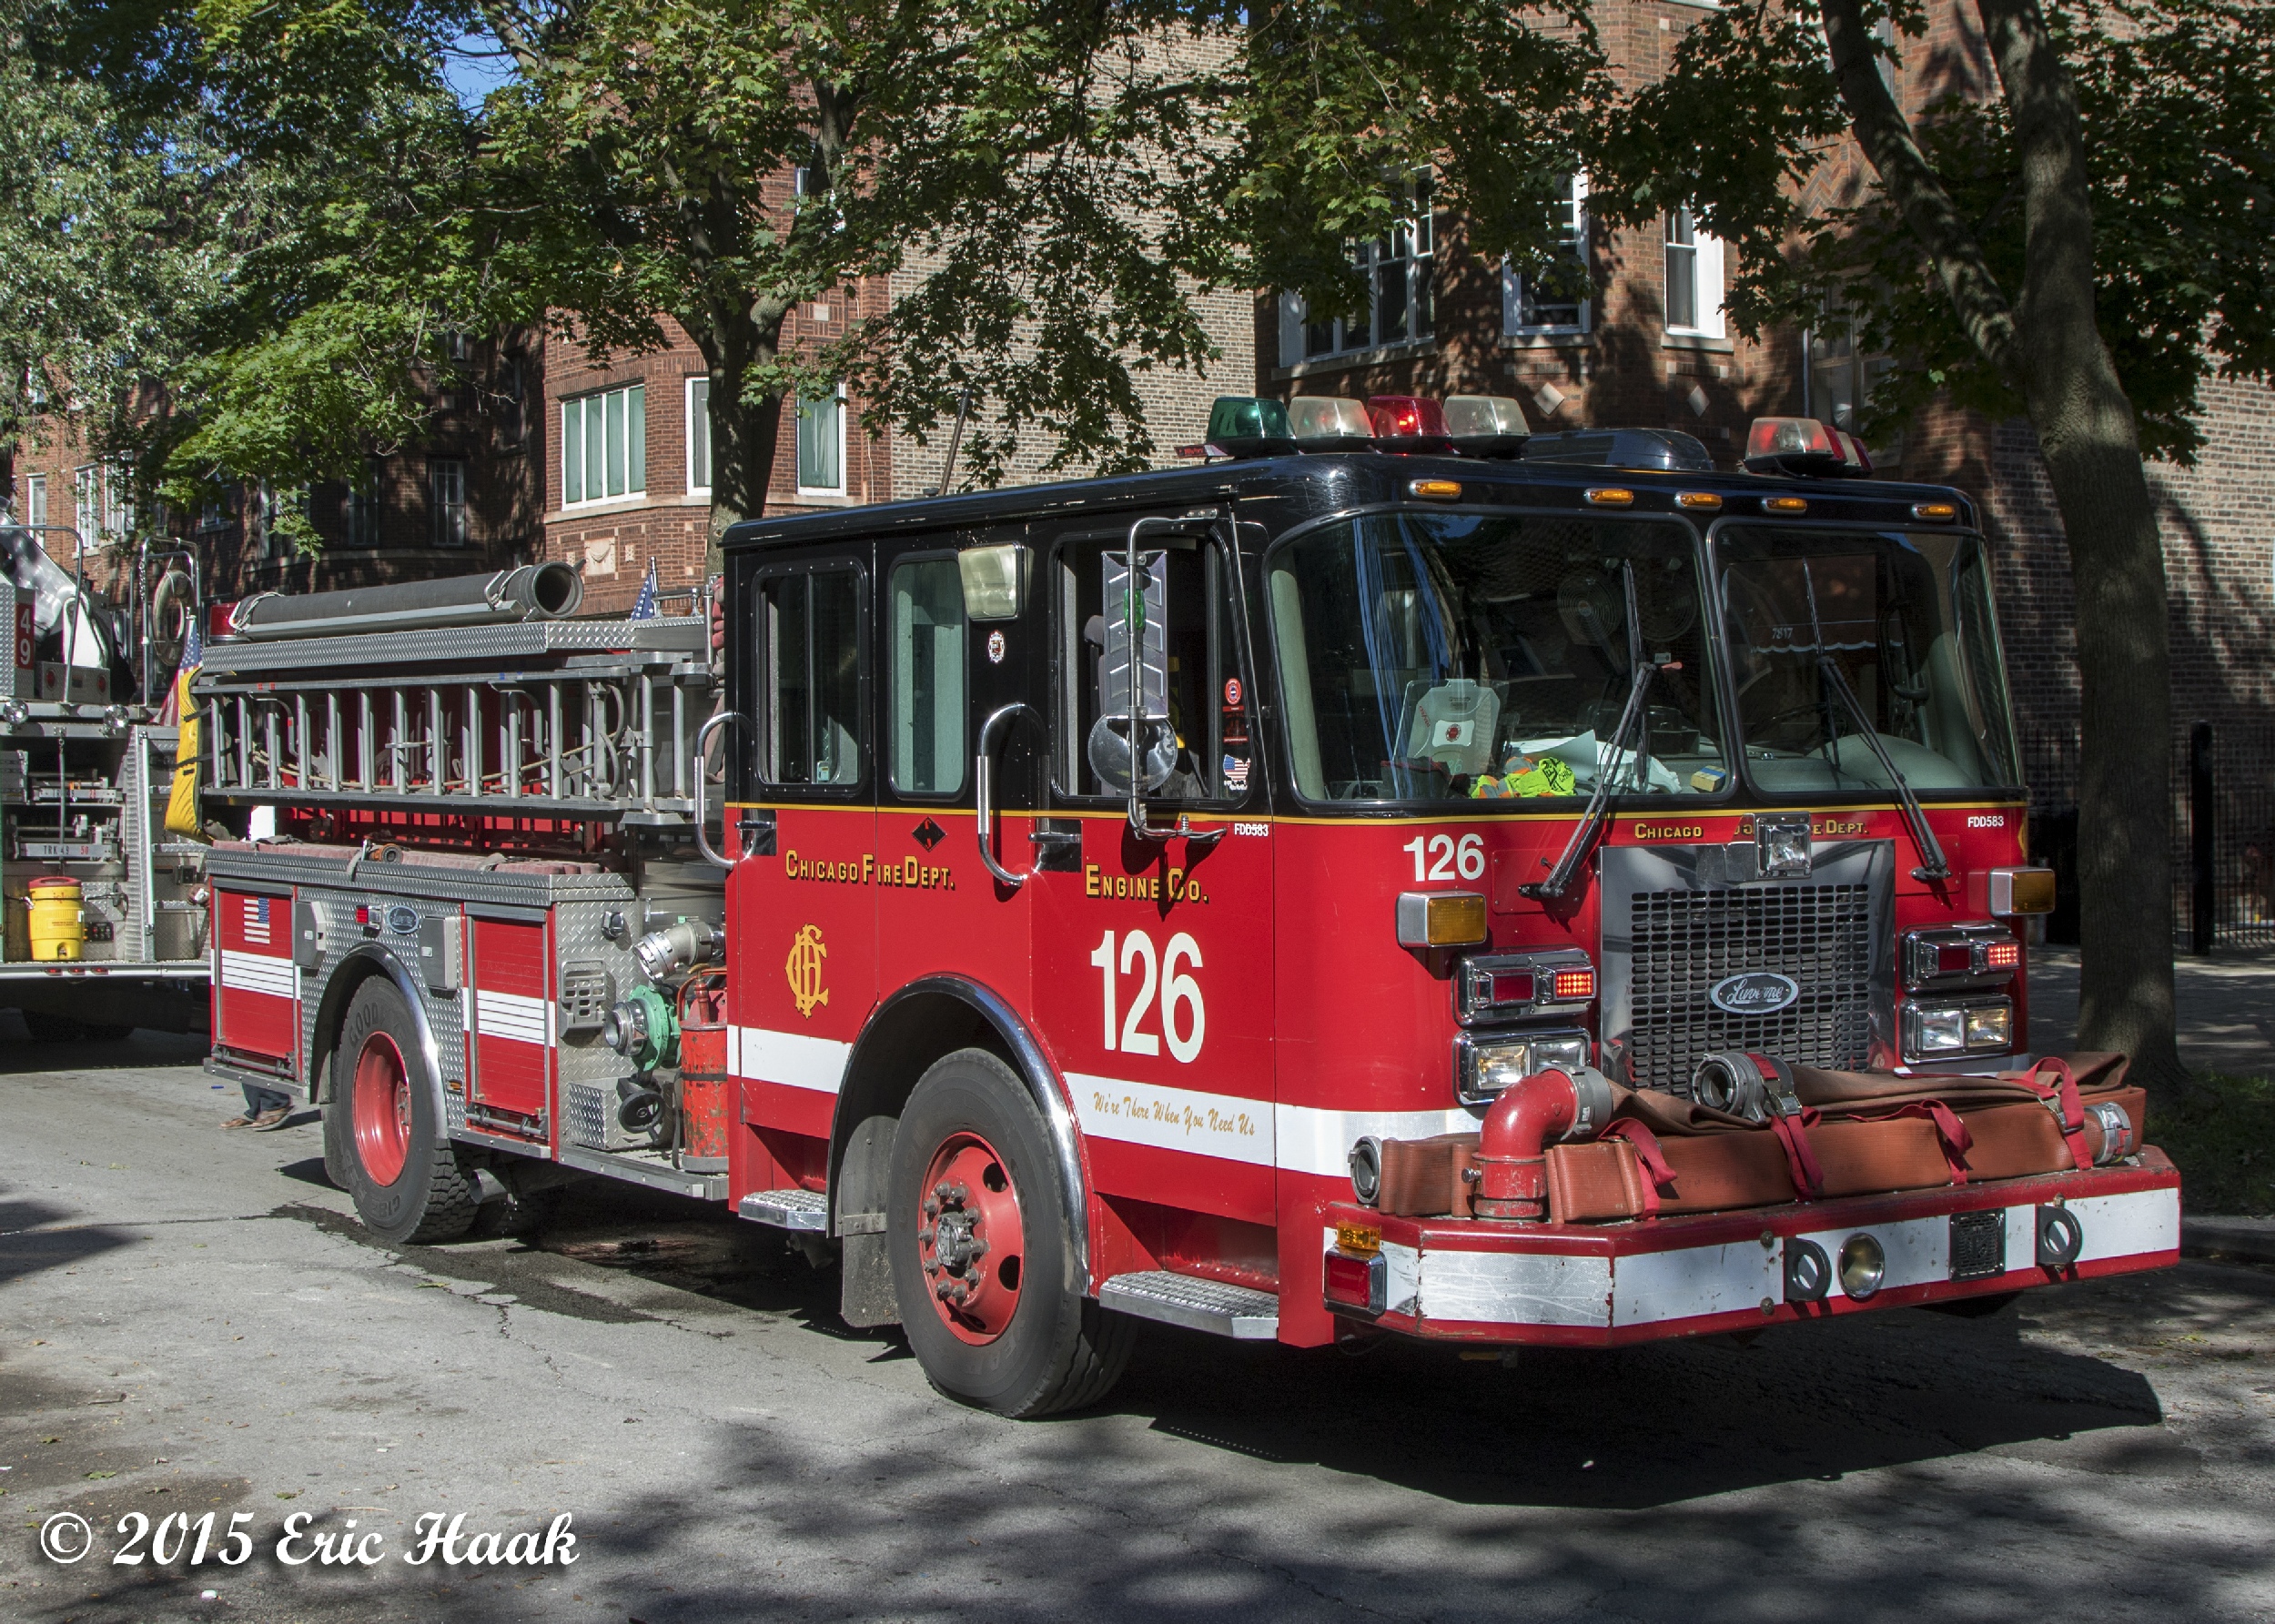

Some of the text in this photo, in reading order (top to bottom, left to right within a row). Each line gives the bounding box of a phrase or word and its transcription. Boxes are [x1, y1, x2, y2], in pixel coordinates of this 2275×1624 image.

[20, 608, 31, 665] 49
[1234, 822, 1269, 837] FDD583
[1967, 815, 2005, 828] FDD583
[43, 845, 89, 855] TRK 49 50
[1403, 833, 1485, 882] 126
[1091, 930, 1206, 1064] 126
[1123, 1096, 1149, 1120] There
[1153, 1101, 1179, 1125] When
[1184, 1105, 1203, 1135] You
[1208, 1108, 1235, 1133] Need
[1239, 1113, 1255, 1135] Us
